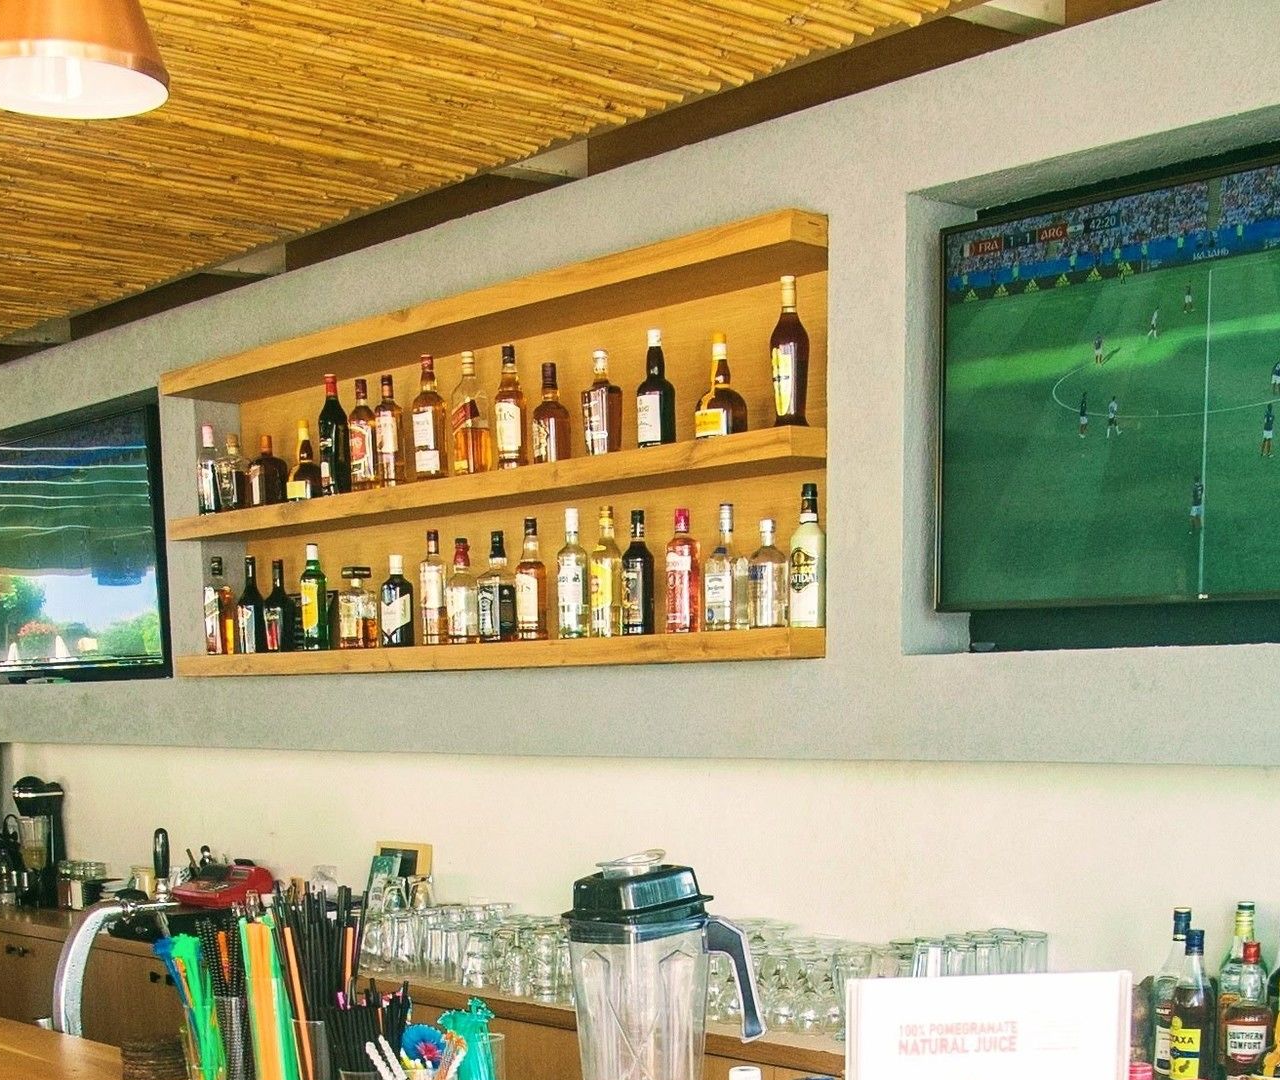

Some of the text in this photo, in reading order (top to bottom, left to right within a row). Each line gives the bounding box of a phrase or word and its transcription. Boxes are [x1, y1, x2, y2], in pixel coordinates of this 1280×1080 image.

[978, 242, 999, 252] FRA
[1040, 226, 1063, 240] ARG
[898, 1036, 1017, 1056] NATURAL JUICE
